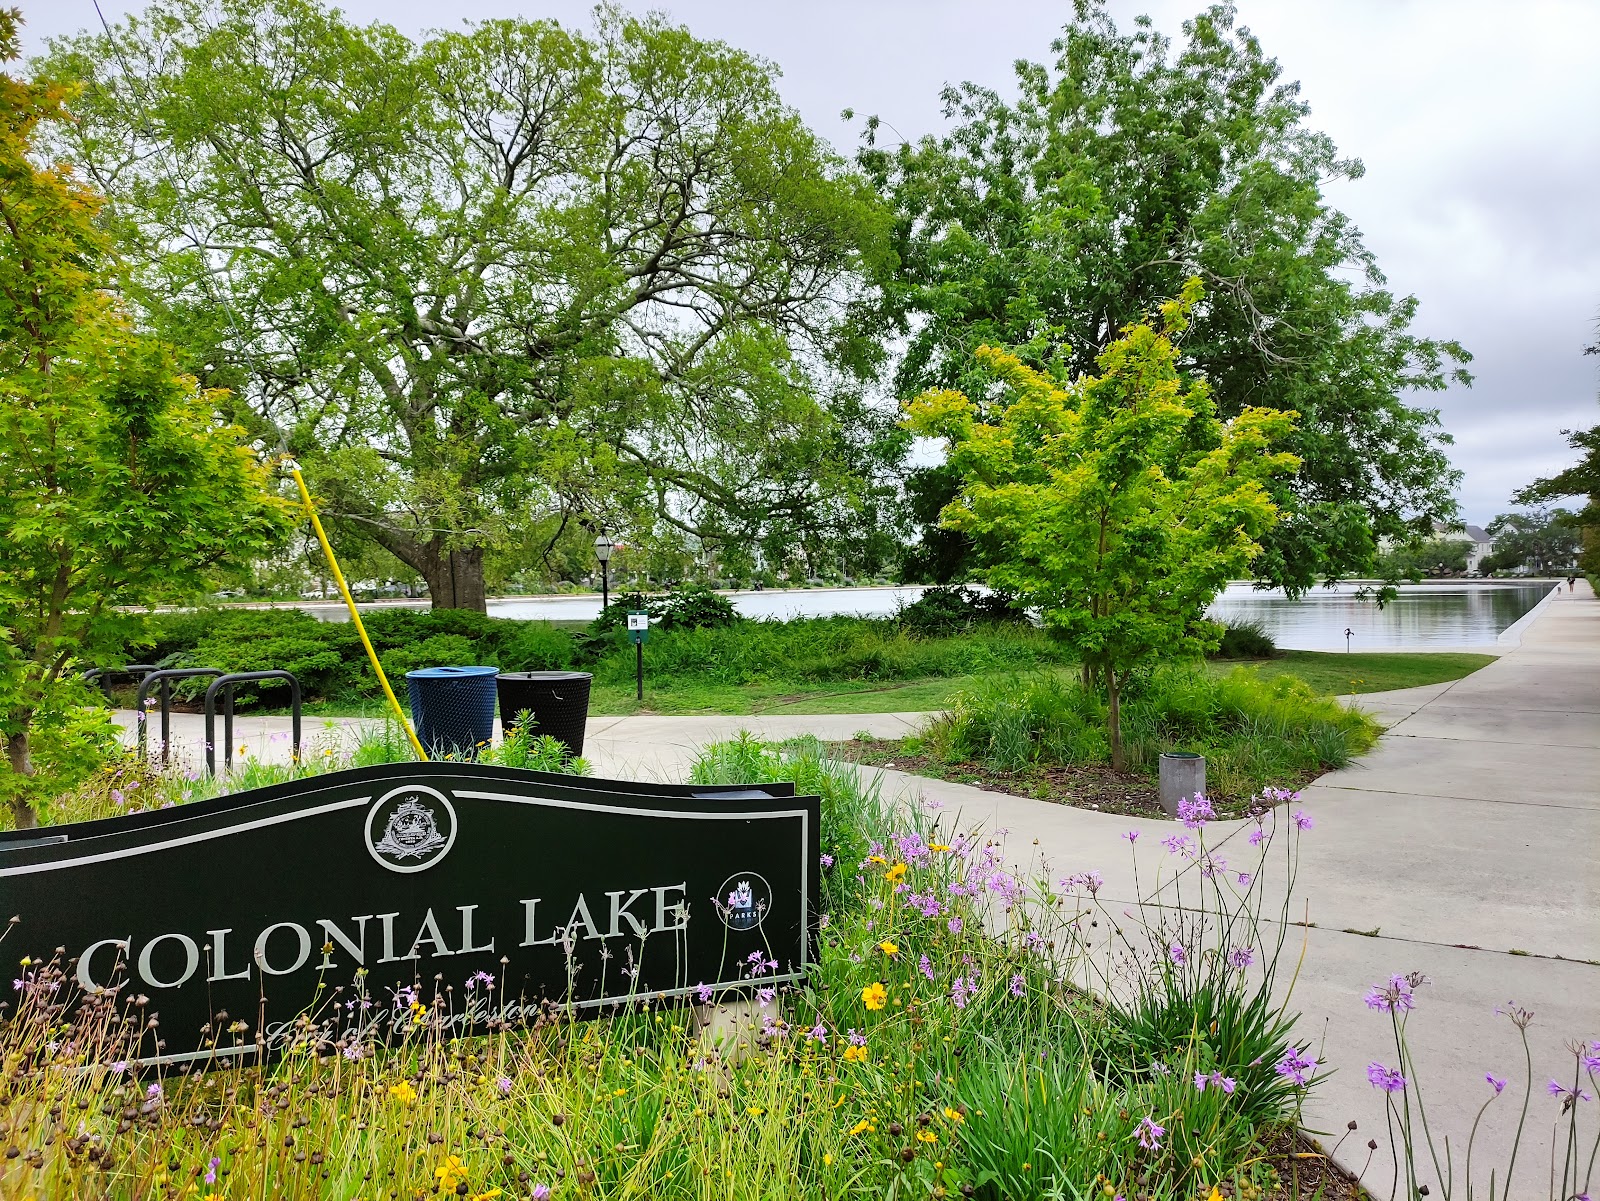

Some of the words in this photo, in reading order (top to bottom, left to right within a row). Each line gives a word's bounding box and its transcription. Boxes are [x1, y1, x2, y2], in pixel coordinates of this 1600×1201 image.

[76, 904, 495, 994] COLONIAL
[519, 881, 687, 947] LAKE
[729, 911, 757, 919] PARKS
